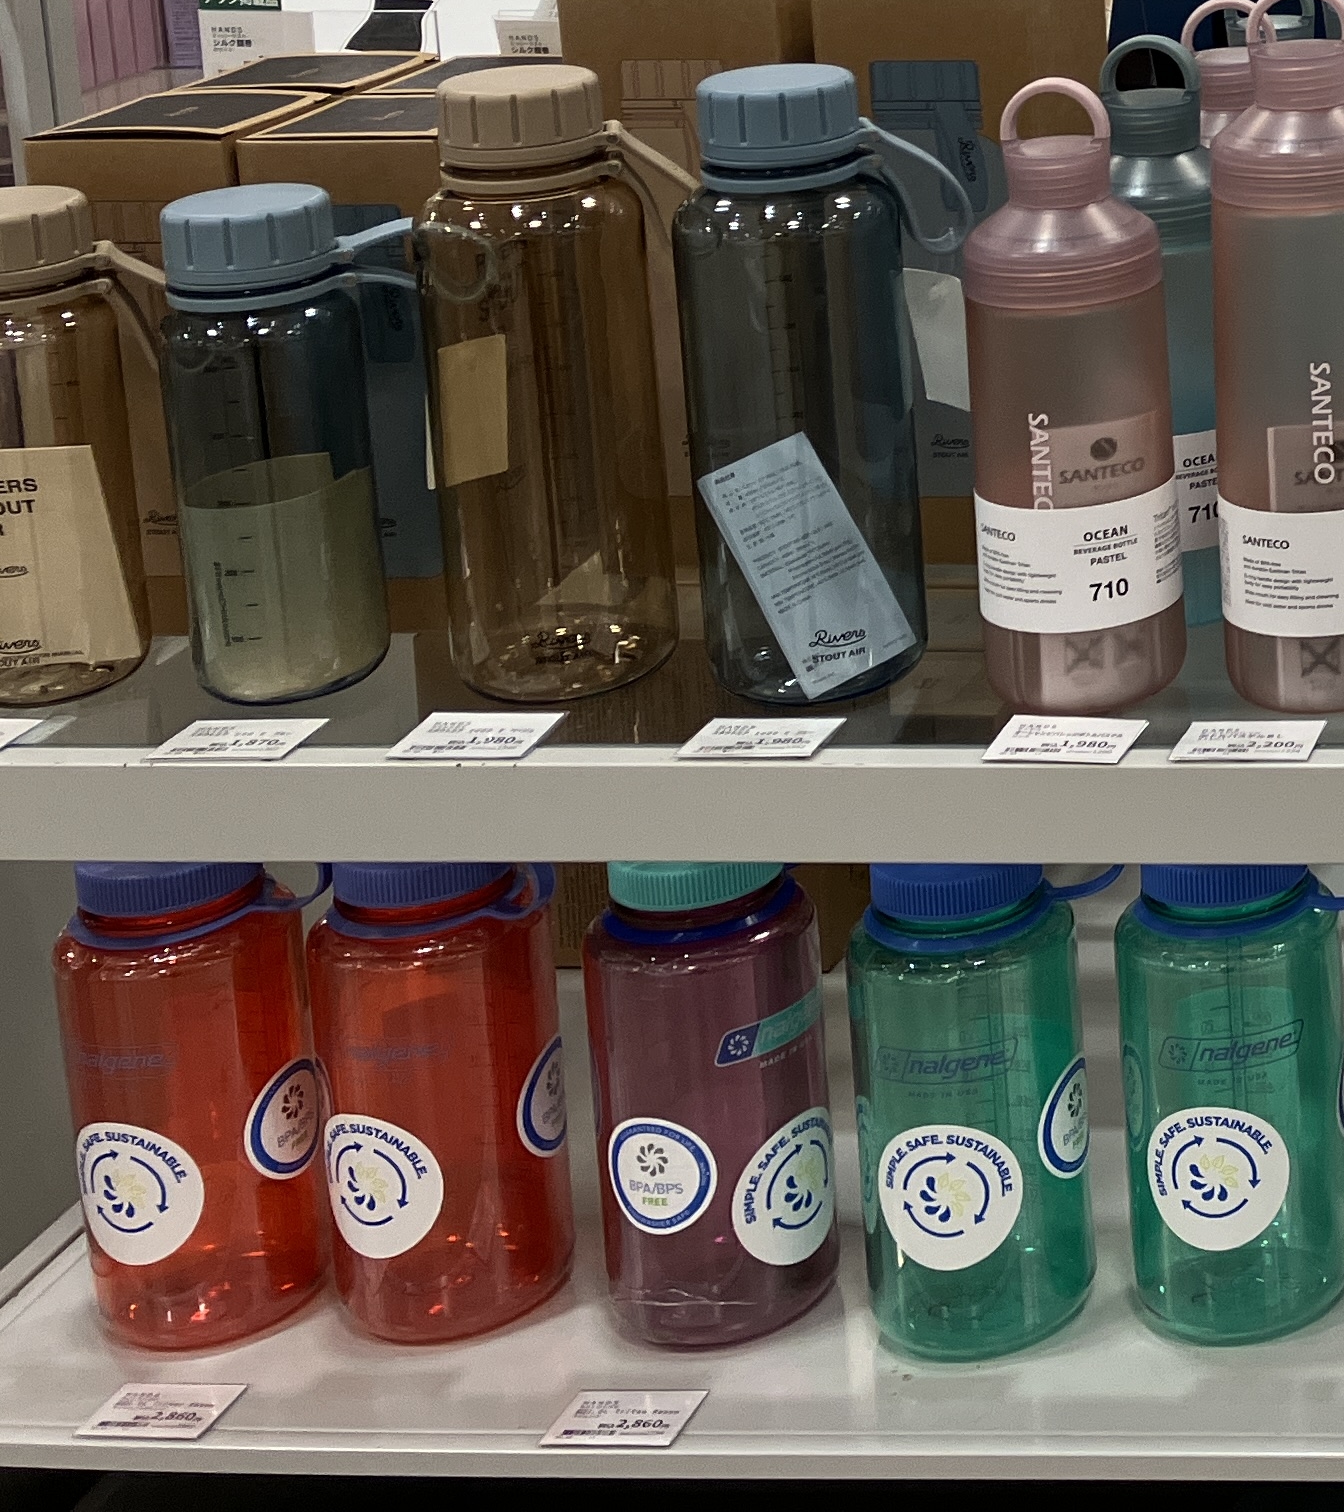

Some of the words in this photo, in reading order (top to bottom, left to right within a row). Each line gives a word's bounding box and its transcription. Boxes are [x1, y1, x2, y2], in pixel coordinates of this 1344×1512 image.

[1083, 525, 1128, 542] OCEAN
[1242, 535, 1290, 550] SANTECO
[1090, 552, 1128, 567] PASTEL
[1089, 578, 1129, 602] 710
[812, 649, 848, 665] STOUT
[850, 646, 866, 658] AIR
[629, 1180, 684, 1196] BPA/BPS
[642, 1197, 668, 1206] FREE
